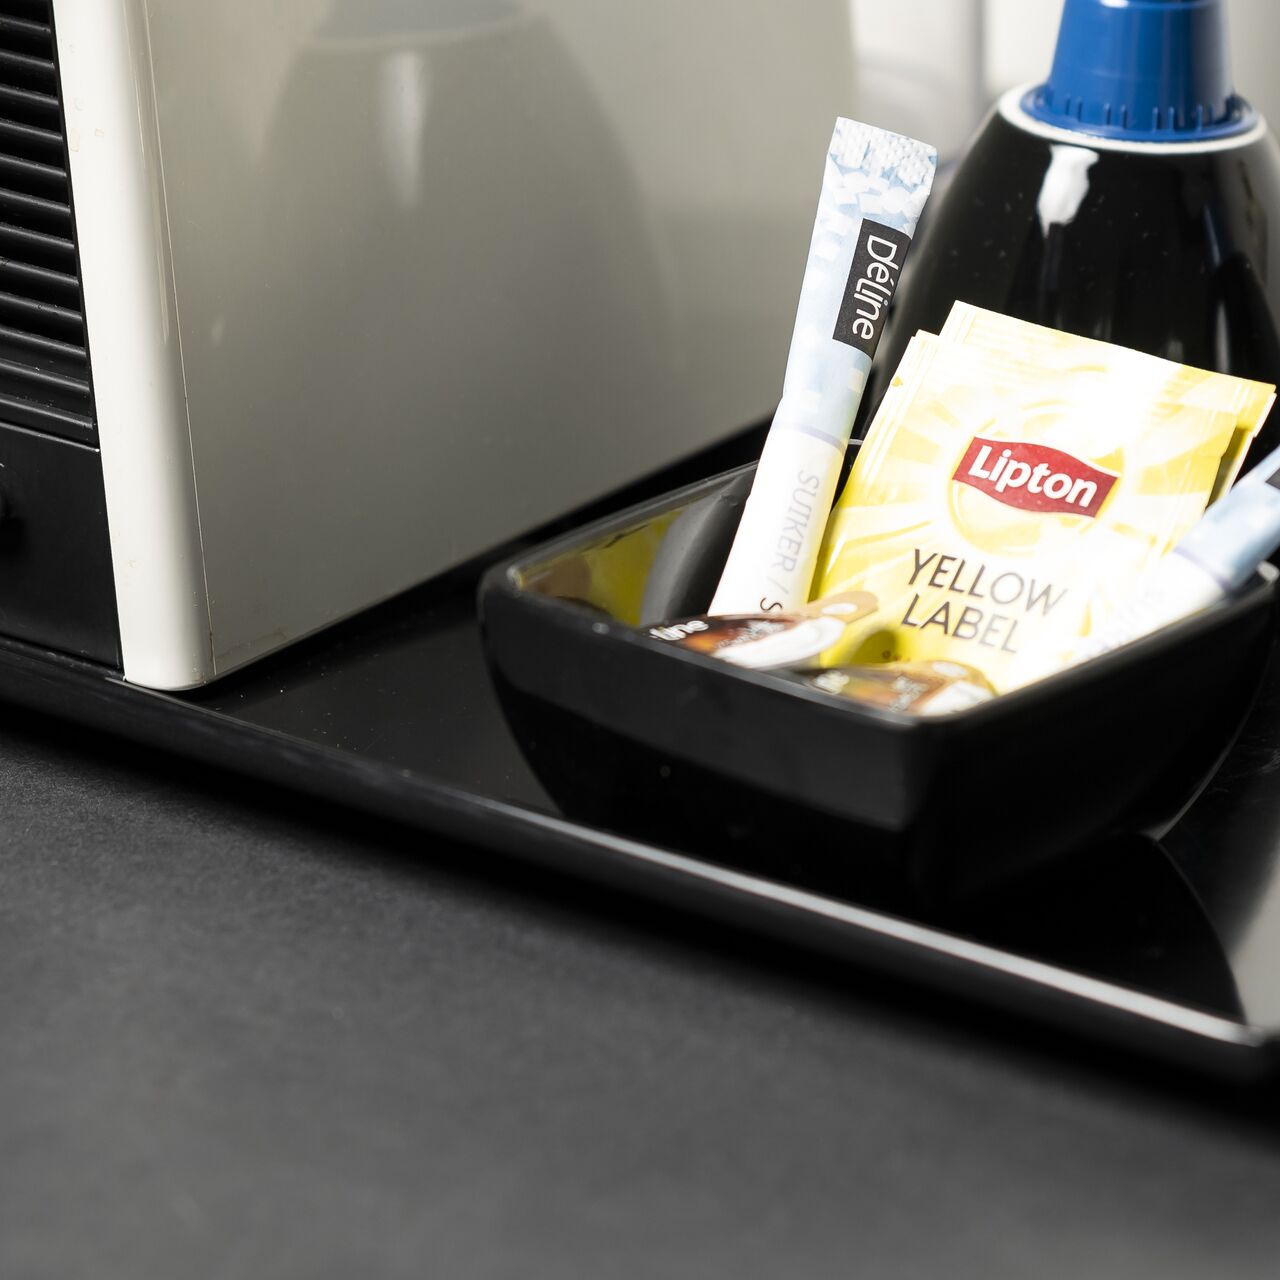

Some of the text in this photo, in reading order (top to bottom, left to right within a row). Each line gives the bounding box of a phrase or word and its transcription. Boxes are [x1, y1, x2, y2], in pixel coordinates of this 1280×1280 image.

[967, 445, 1098, 508] Lipton
[771, 469, 820, 572] SUIKER
[908, 548, 1068, 616] YELLOW
[901, 593, 1019, 654] LABEL
